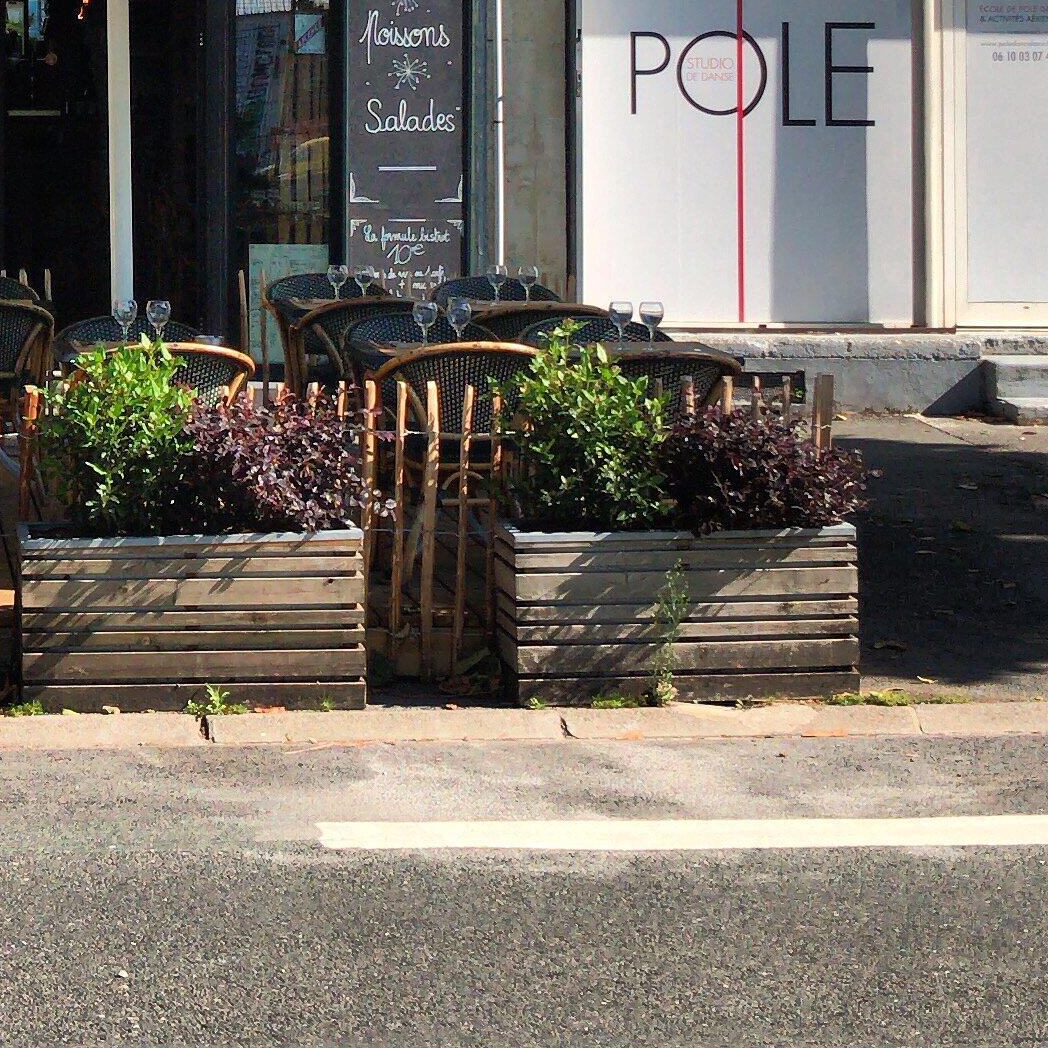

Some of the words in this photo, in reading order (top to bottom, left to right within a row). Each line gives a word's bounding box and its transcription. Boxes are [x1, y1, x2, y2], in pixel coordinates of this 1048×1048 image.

[359, 10, 450, 65] Poissons
[687, 57, 734, 70] STUDIO
[992, 51, 1003, 62] 06
[1006, 51, 1017, 62] 10
[1032, 51, 1043, 62] 07
[629, 21, 876, 127] POLE
[686, 72, 697, 82] DE
[701, 72, 736, 82] DANSE
[365, 98, 456, 134] Salades
[380, 225, 418, 252] formule
